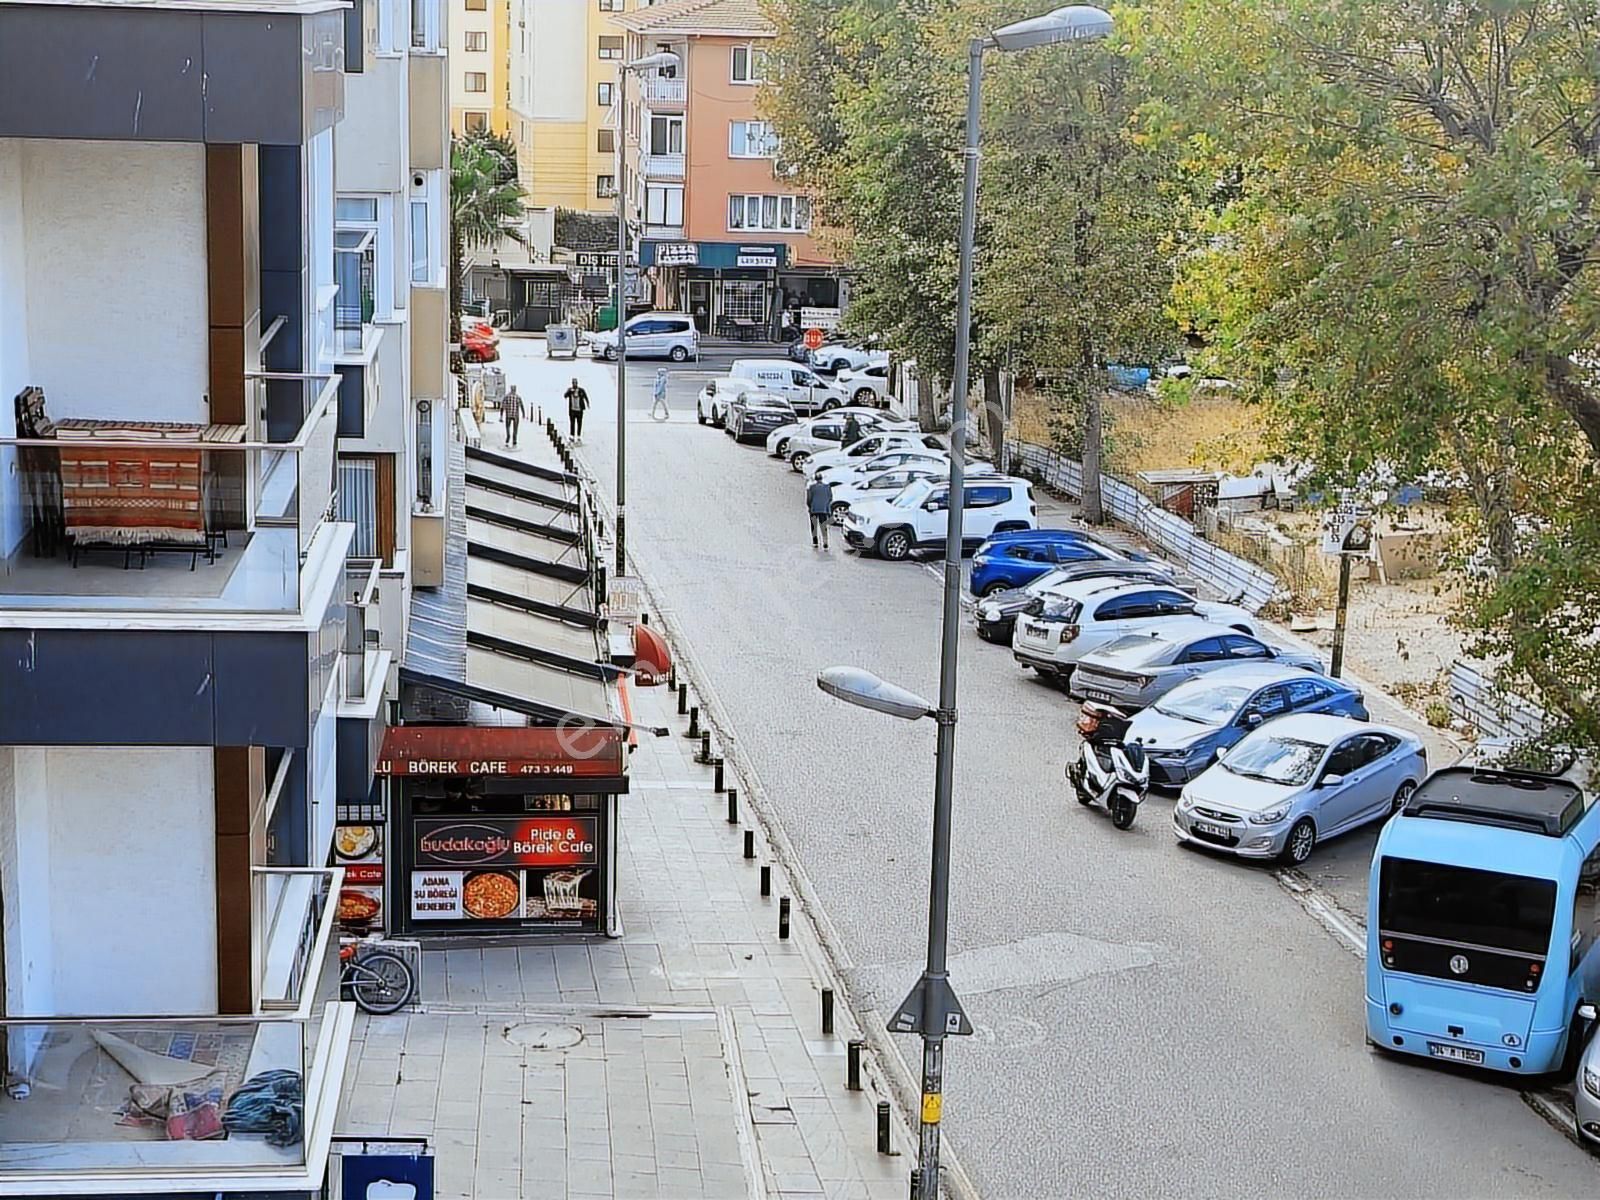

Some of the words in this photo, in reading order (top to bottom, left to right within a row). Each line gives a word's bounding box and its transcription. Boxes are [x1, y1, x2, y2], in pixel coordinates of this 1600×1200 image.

[409, 759, 457, 773] BÖREK
[470, 761, 507, 773] CAFE
[531, 828, 562, 841] Pide
[566, 828, 576, 840] &
[513, 841, 553, 854] Börek
[558, 841, 593, 853] Cafe
